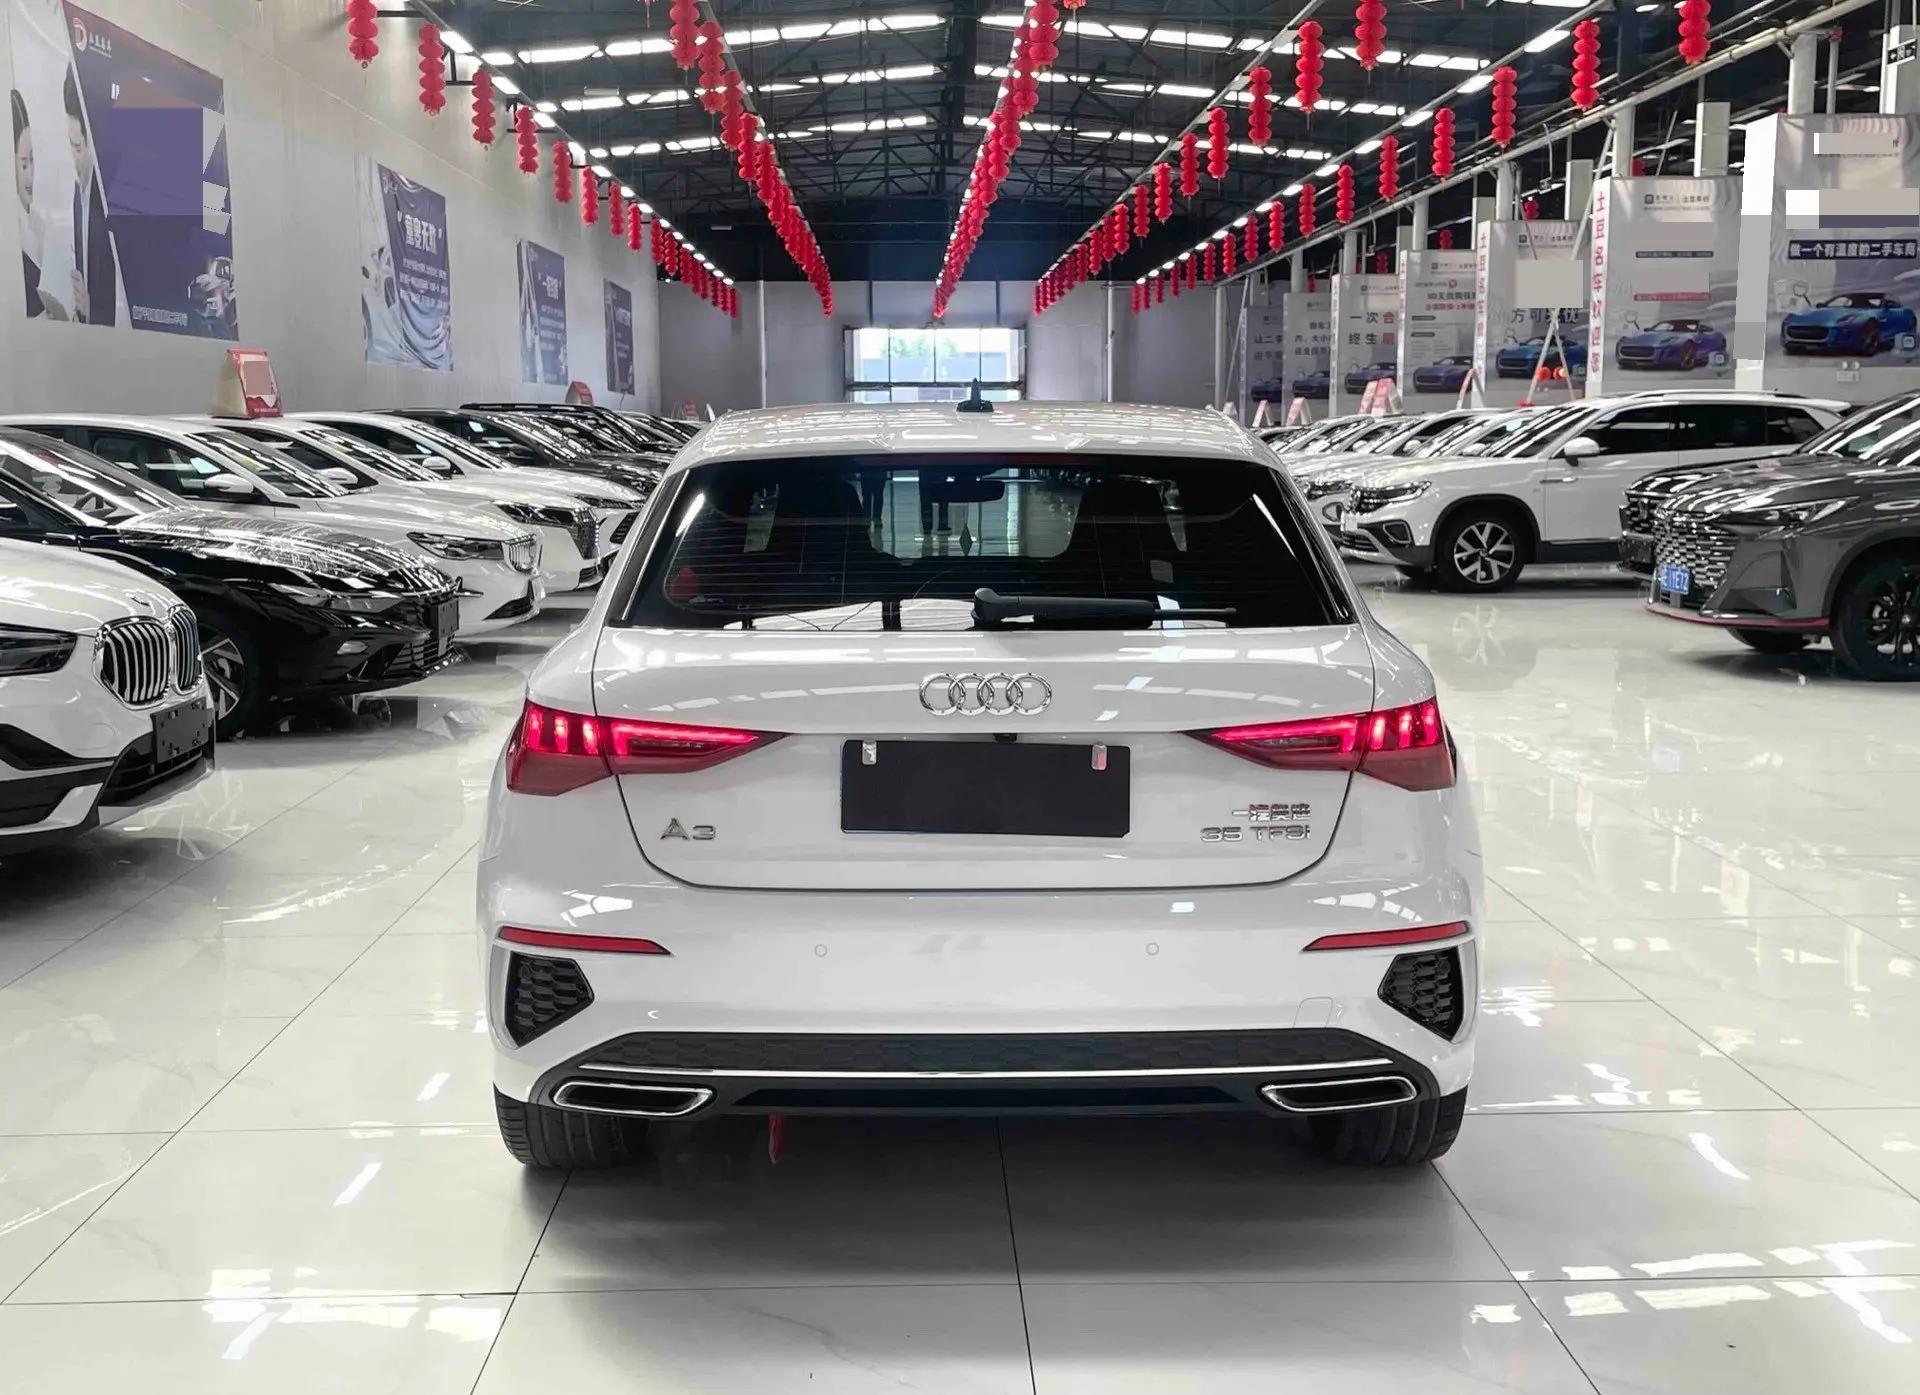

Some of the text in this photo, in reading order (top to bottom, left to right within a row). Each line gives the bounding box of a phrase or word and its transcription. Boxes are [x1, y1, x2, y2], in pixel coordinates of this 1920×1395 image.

[1790, 241, 1917, 258] 做一个有温度的二手车商
[660, 818, 716, 841] A3
[1201, 825, 1310, 842] 35 TFSI
